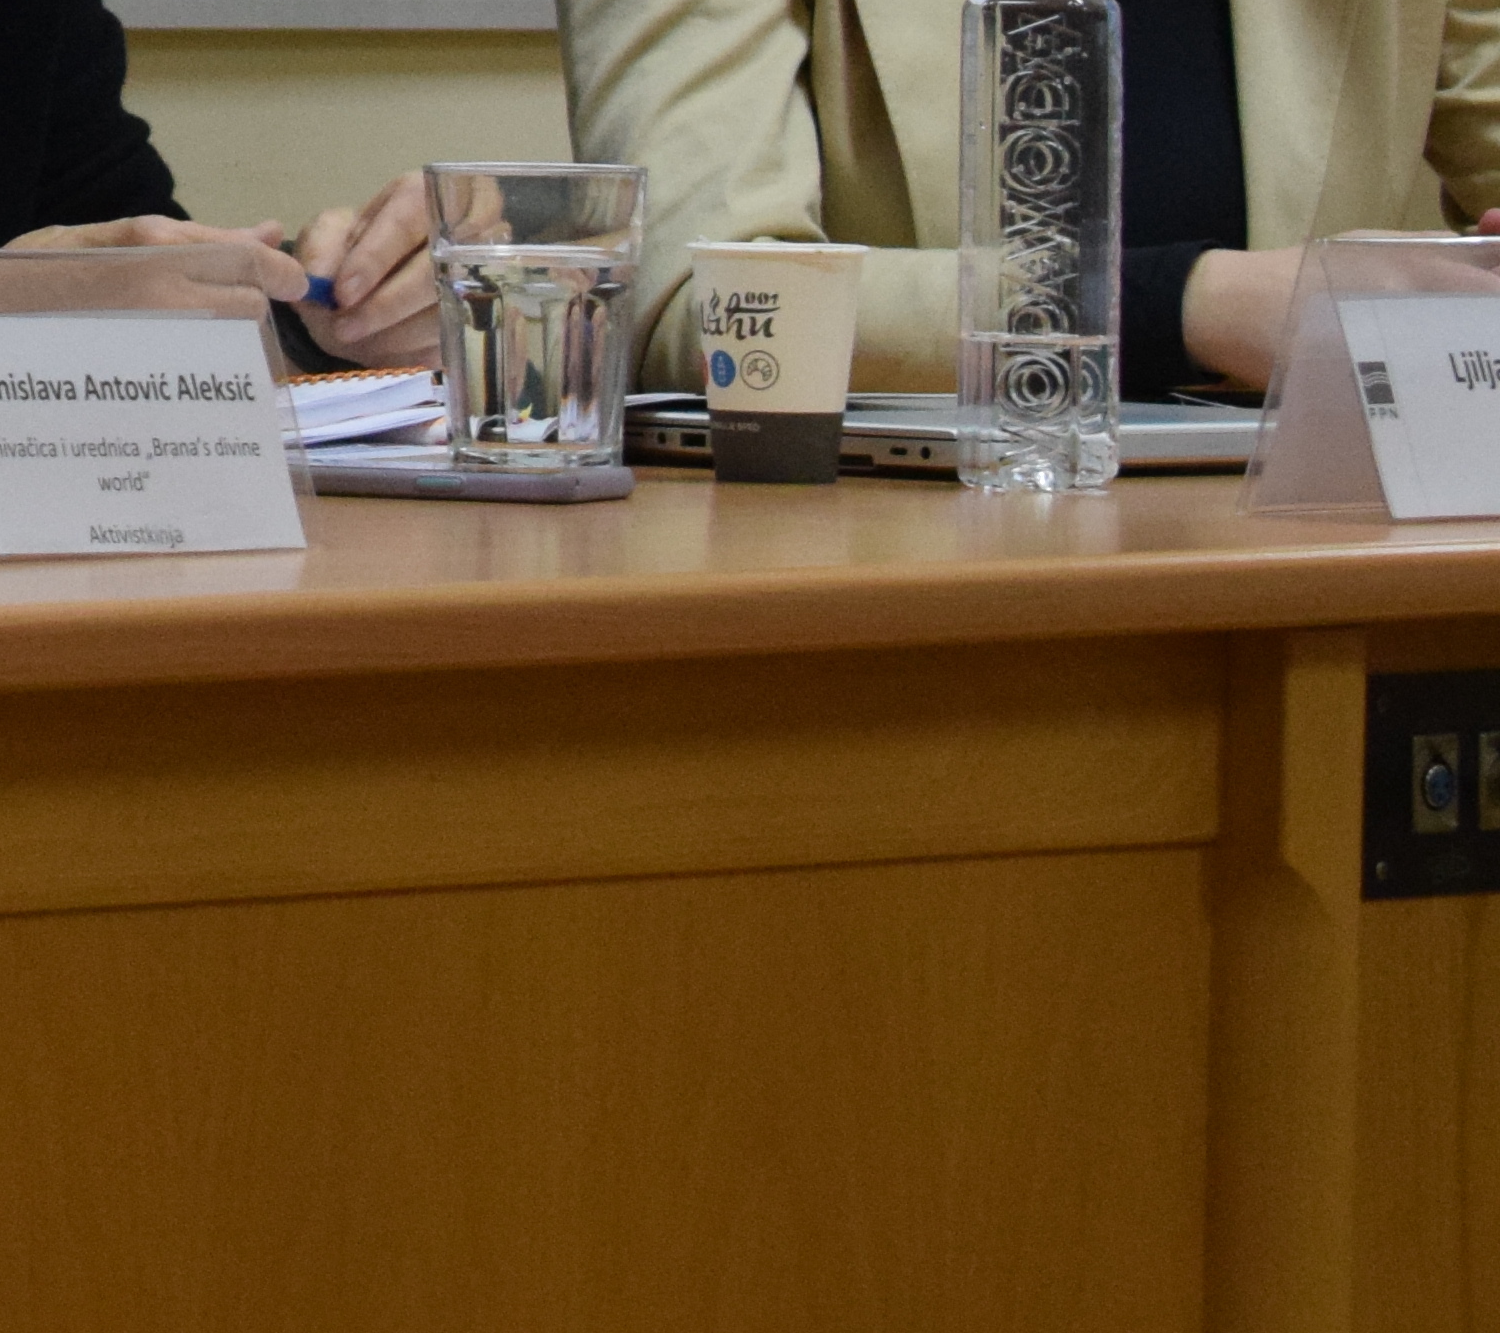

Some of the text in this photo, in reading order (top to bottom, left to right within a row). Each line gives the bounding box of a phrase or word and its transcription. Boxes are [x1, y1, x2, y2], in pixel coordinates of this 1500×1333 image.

[83, 372, 172, 402] Antović
[177, 372, 256, 402] Aleksić
[71, 437, 141, 459] urednica
[215, 437, 261, 459] divine
[89, 524, 185, 547] Aktivistkinja
